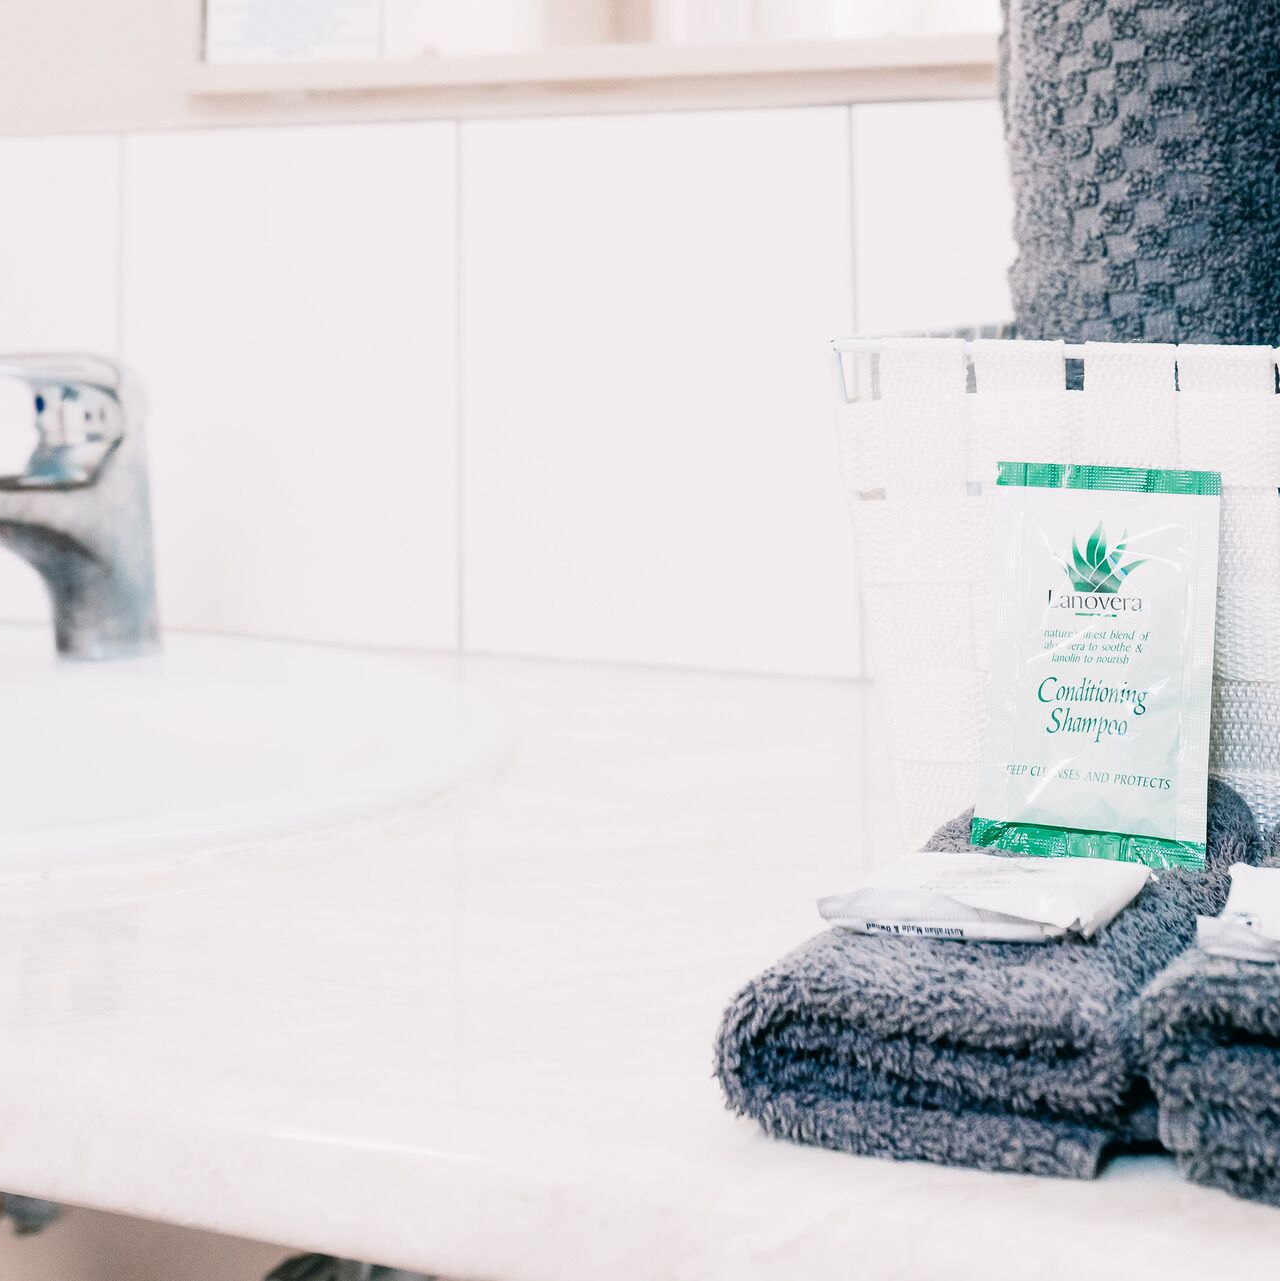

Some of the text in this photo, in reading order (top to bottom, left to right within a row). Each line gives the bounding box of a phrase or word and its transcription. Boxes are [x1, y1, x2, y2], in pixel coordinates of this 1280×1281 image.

[1048, 589, 1142, 612] Lanovera
[1044, 627, 1078, 639] nature'
[1110, 630, 1135, 641] blend
[1043, 639, 1059, 650] alo
[1088, 642, 1098, 651] to
[1101, 642, 1132, 653] soothe
[1135, 643, 1144, 654] &
[1083, 654, 1093, 664] to
[1095, 654, 1130, 665] nourish
[1037, 676, 1148, 716] Conditioning
[1045, 706, 1129, 744] Shampoo
[1030, 765, 1081, 781] CLENSES
[1084, 771, 1110, 784] AND
[1113, 773, 1172, 790] PROTECTS
